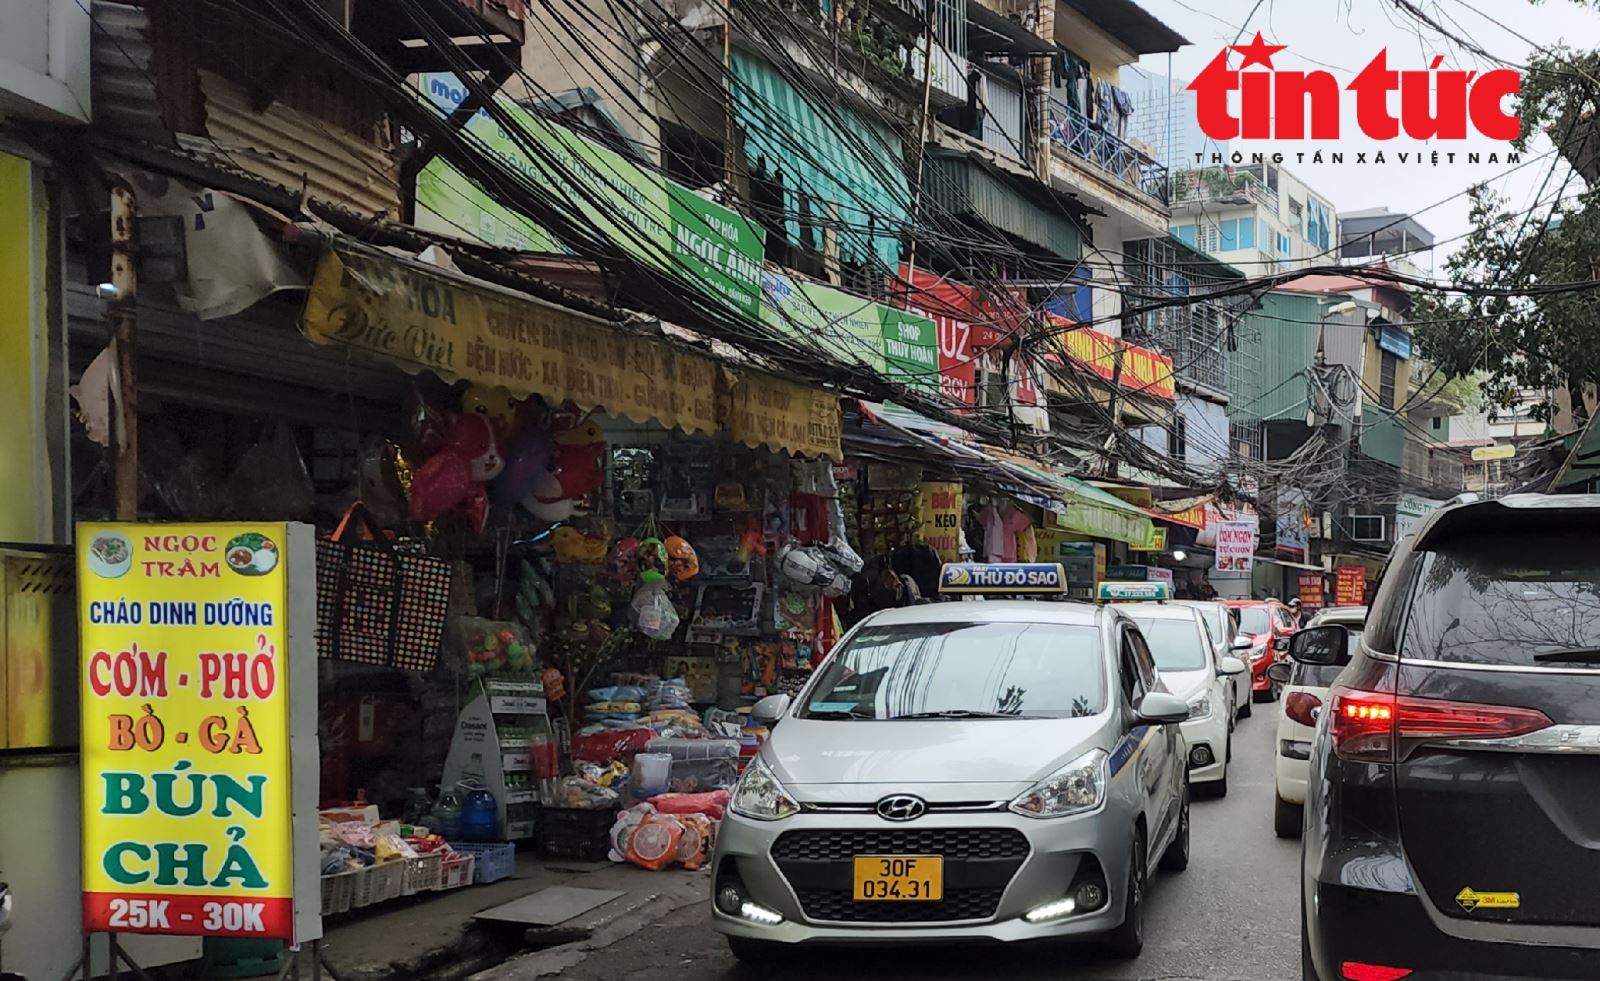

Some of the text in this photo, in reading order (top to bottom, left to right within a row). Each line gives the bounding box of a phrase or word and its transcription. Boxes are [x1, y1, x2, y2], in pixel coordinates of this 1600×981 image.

[704, 213, 739, 243] TẠP HÓA
[676, 223, 724, 273] NGỌC
[898, 321, 921, 341] SHOP
[144, 535, 217, 557] NGỌC
[141, 559, 221, 578] TRÂM
[1004, 568, 1027, 585] ĐÔ
[1027, 571, 1058, 585] SAO
[90, 597, 273, 626] CHÁO DINH DƯỠNG
[89, 643, 168, 698] CƠM
[199, 634, 276, 699] PHỞ
[107, 703, 164, 751] BÒ
[198, 705, 262, 754] GÀ
[100, 760, 268, 818] BÚN
[102, 826, 269, 889] CHẢ
[879, 859, 918, 878] 30F
[863, 880, 931, 899] 034.31
[108, 899, 170, 930] 25K
[203, 902, 266, 931] 30K
